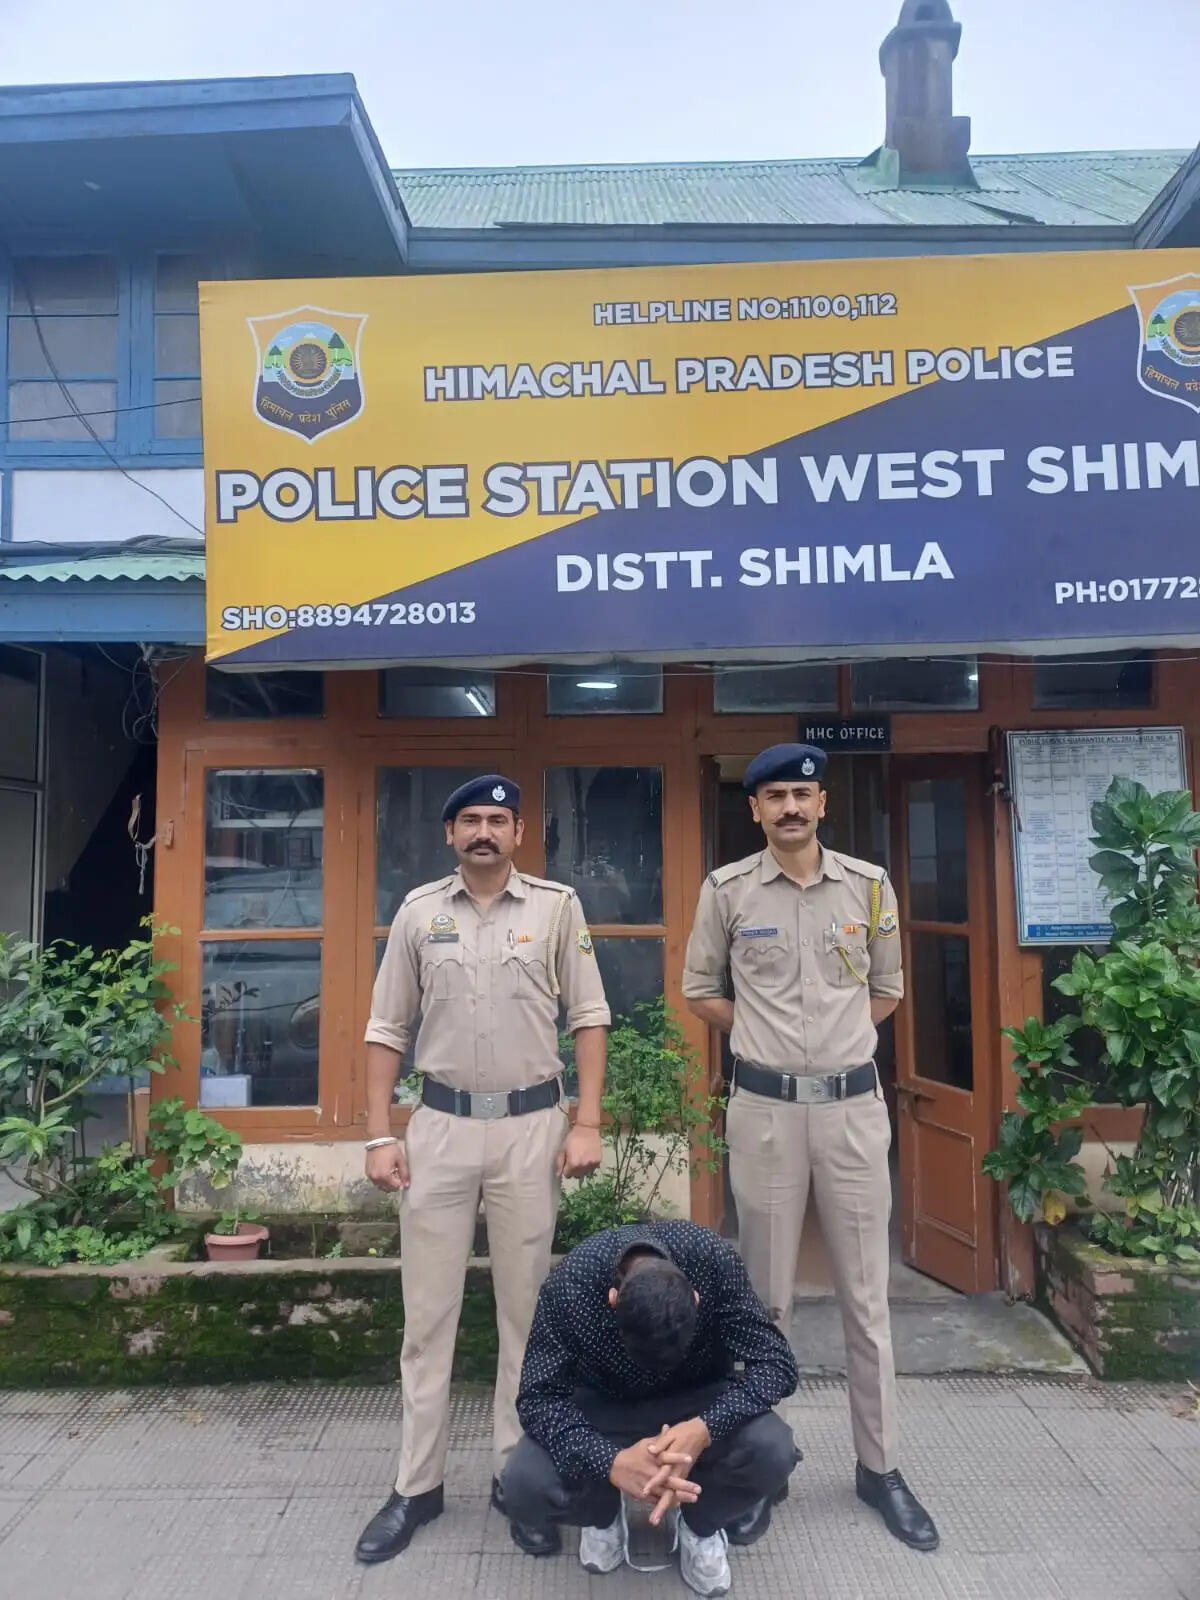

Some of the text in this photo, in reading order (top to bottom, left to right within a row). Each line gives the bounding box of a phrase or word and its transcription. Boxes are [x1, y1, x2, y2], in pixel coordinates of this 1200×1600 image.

[594, 293, 898, 325] HELPLINE NO:1100,112
[424, 345, 1075, 402] HIMACHAL PRADESH POLICE
[260, 396, 351, 424] हिमाचल प्रदेश पुलिस
[216, 440, 1200, 524] POLICE STATION WEST SHIM
[556, 541, 955, 593] DISTT. SHIMLA
[1055, 576, 1200, 604] PH:01772
[221, 602, 477, 630] SHO:8894728013
[806, 727, 884, 740] MHC OFFICE
